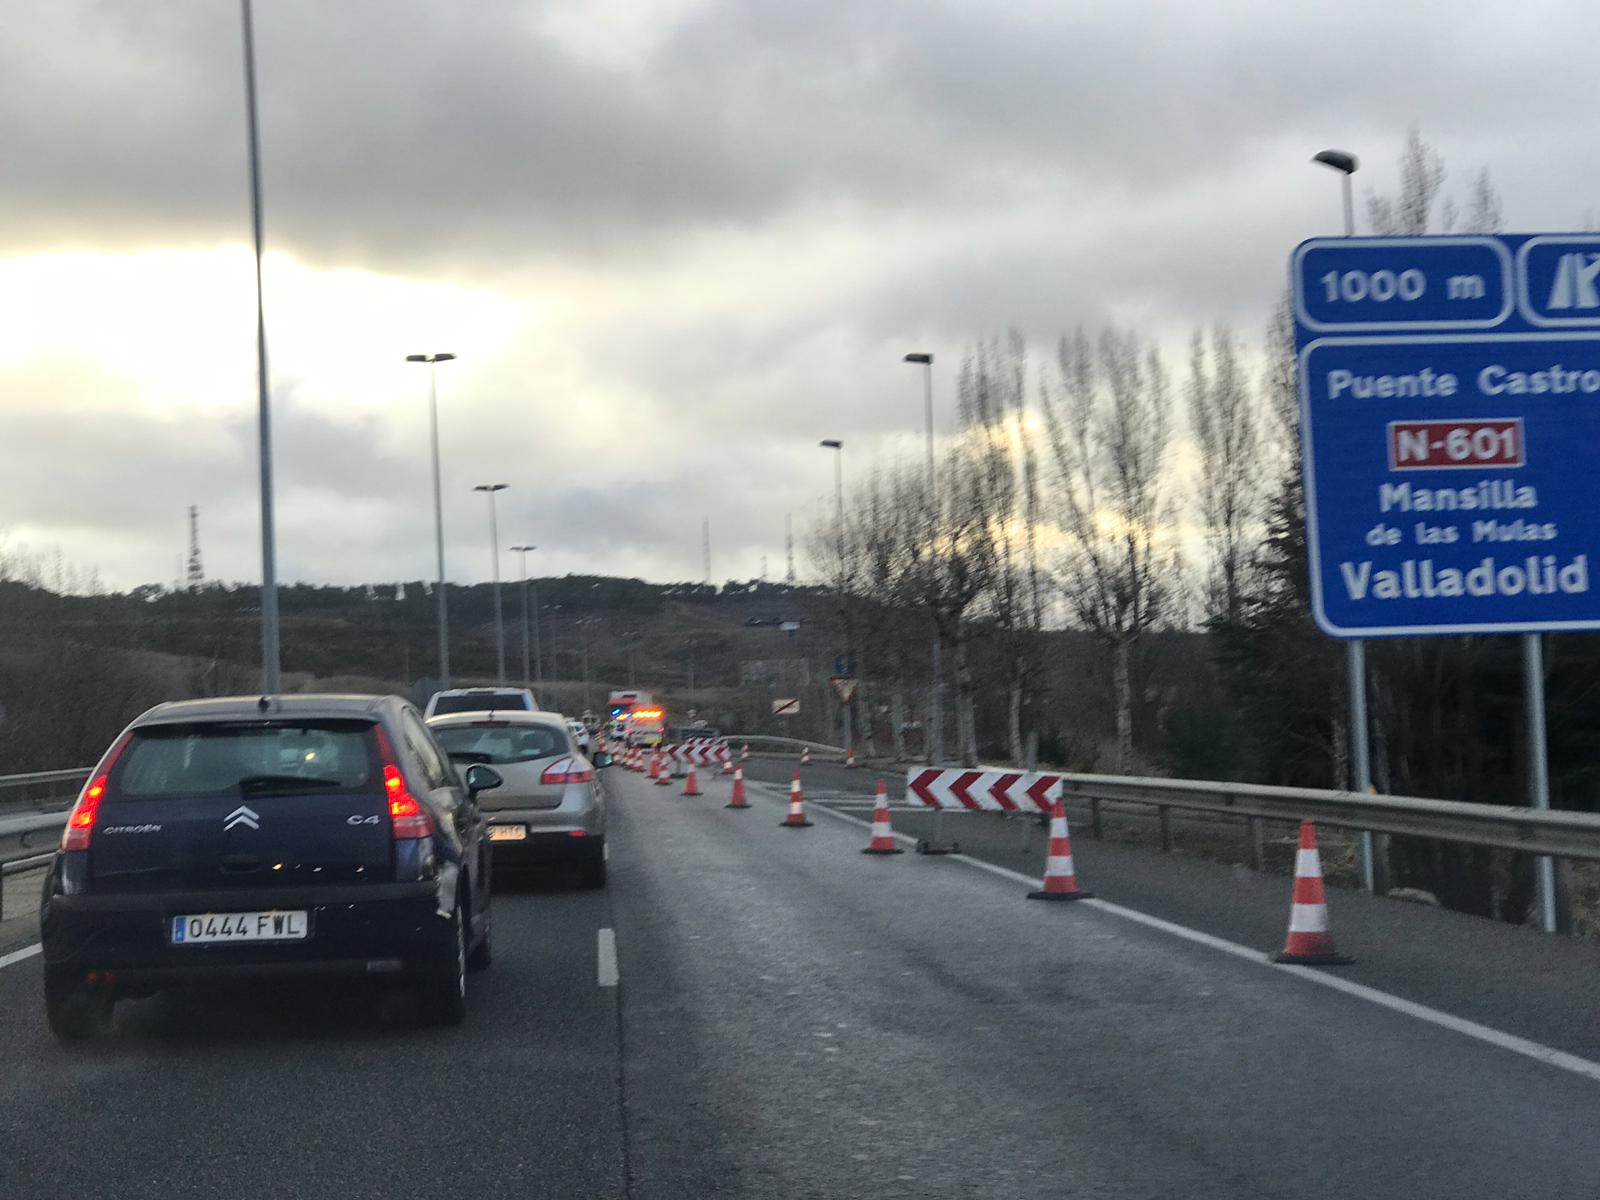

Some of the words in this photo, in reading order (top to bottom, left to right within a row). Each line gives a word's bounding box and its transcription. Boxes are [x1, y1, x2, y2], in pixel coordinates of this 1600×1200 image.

[1320, 269, 1426, 303] 1000
[1446, 274, 1486, 301] m
[1327, 369, 1458, 399] Puente
[1478, 364, 1600, 396] Castro
[1397, 427, 1518, 463] N-601
[1379, 479, 1538, 512] Mansilla
[1365, 523, 1402, 546] de
[1415, 521, 1460, 545] las
[1472, 518, 1558, 544] Mulas
[1339, 554, 1590, 600] Valladolid
[347, 814, 381, 826] C4
[189, 917, 248, 939] 0444
[256, 914, 301, 936] FWL
